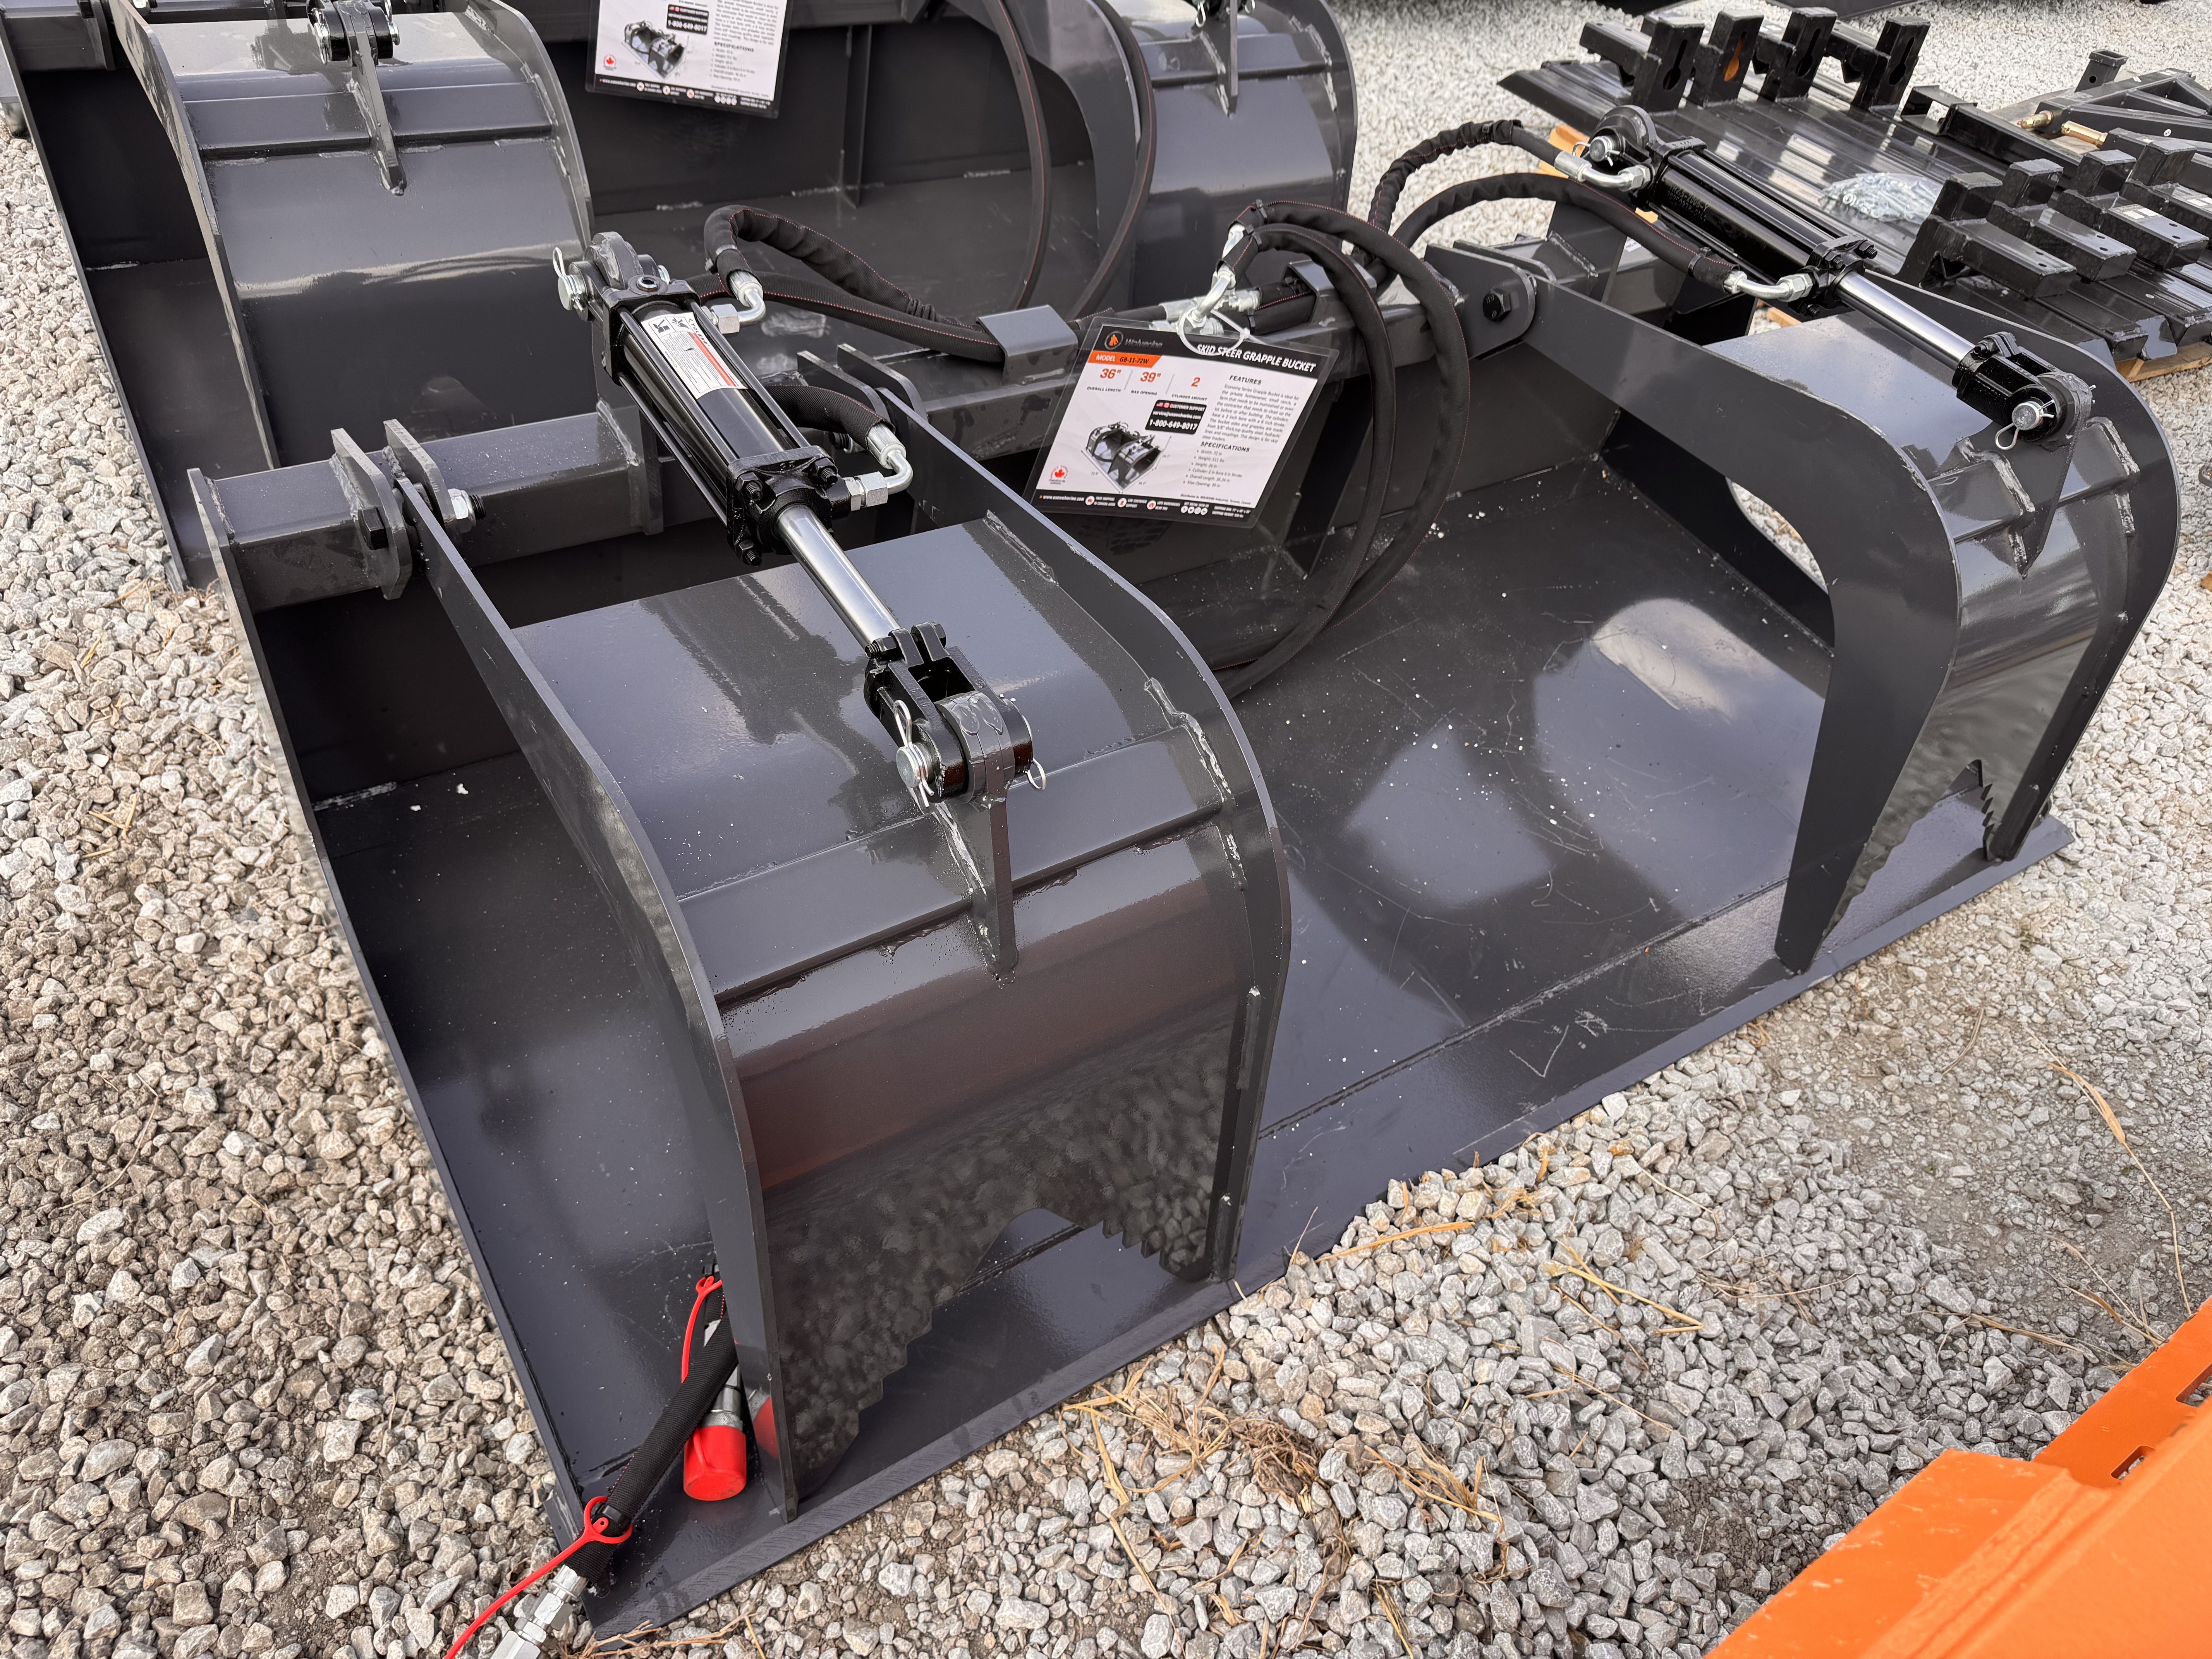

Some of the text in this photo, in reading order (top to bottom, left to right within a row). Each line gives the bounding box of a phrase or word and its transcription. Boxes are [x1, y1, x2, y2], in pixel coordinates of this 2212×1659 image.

[1125, 338, 1163, 349] Wolverine
[1096, 354, 1116, 362] MODEL
[1197, 343, 1317, 373] SKID STEER GRAPPLE BUCKET
[1100, 368, 1121, 379] 36"
[1140, 371, 1161, 383] 39"
[1191, 377, 1200, 387] 2
[1229, 375, 1262, 385] FEATURES
[1149, 419, 1198, 430] 1-800-649-8017
[1200, 441, 1250, 452] SPECIFICATIONS
